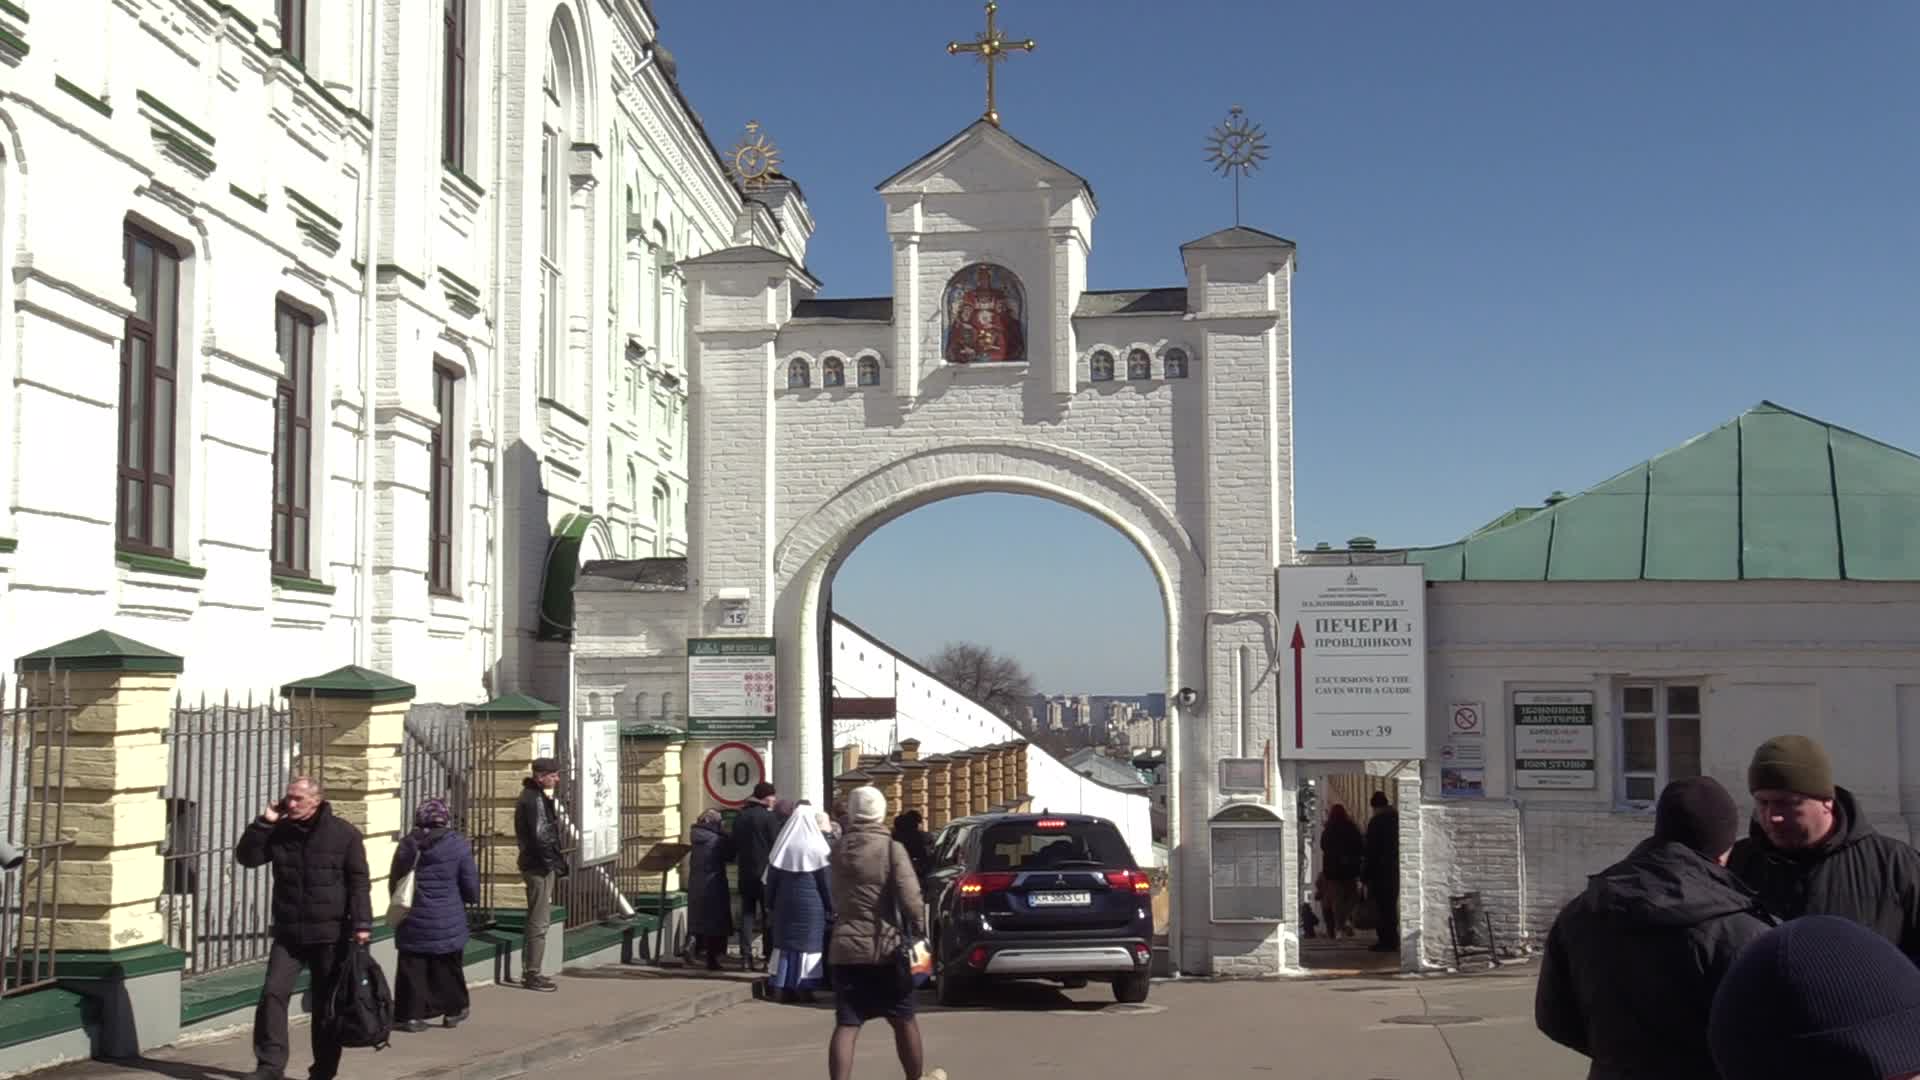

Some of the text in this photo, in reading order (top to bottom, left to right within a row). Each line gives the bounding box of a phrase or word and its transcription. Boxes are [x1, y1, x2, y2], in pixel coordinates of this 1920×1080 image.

[729, 613, 743, 624] 15
[1315, 618, 1398, 633] ПЕЧЕРИ
[1315, 637, 1412, 649] ПРОВІДНИКОМ
[1315, 676, 1409, 684] EXCURSIONS TO THE
[1315, 687, 1411, 695] CAVES WITH A GUIDE
[1331, 725, 1392, 737] КОРПУС 39
[717, 762, 750, 787] 10
